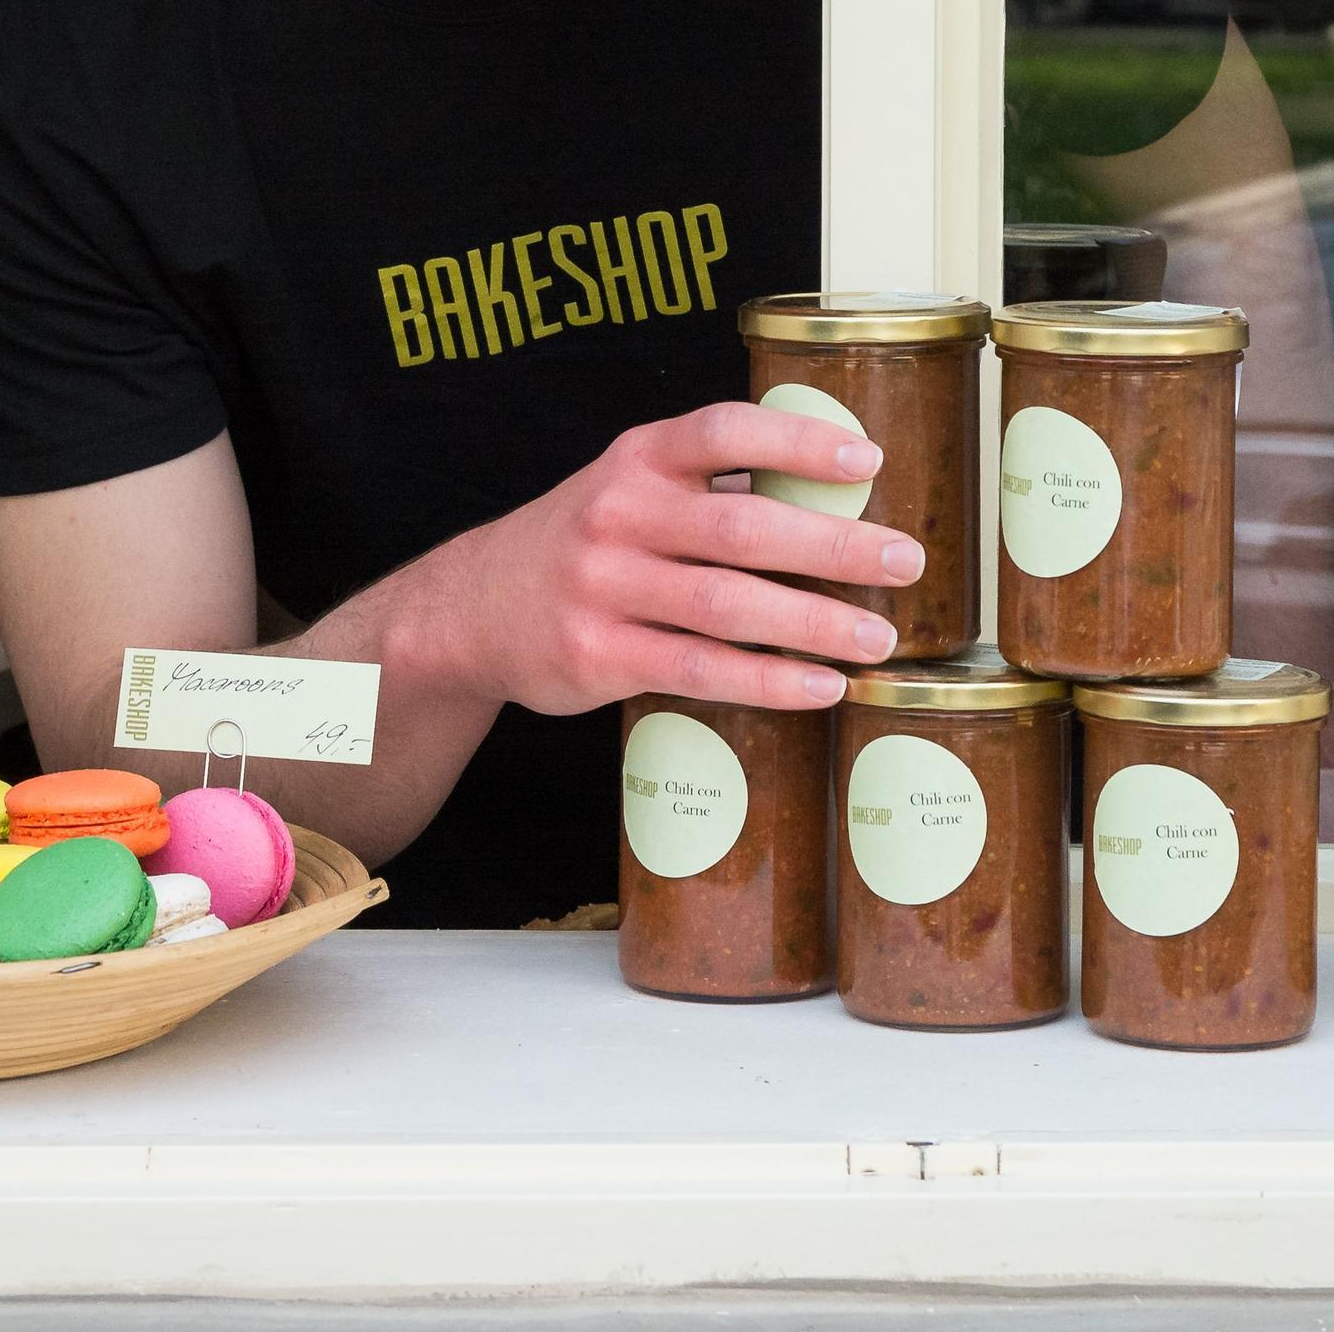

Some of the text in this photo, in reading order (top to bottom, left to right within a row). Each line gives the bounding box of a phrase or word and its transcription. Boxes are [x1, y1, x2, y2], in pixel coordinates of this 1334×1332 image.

[378, 203, 728, 367] BAKESHOP
[1043, 472, 1101, 489] Chili con
[1051, 493, 1090, 509] Carne
[163, 663, 304, 695] Macaroons
[125, 655, 156, 741] BAKESHOP
[665, 780, 721, 798] Chili con
[910, 791, 971, 806] Chili con
[673, 801, 711, 816] Carne
[852, 806, 892, 826] BAKESHOP
[921, 813, 962, 827] Carne
[1156, 824, 1218, 839] Chili con
[1098, 834, 1142, 856] BAKESHOP
[1166, 846, 1208, 859] Carne
